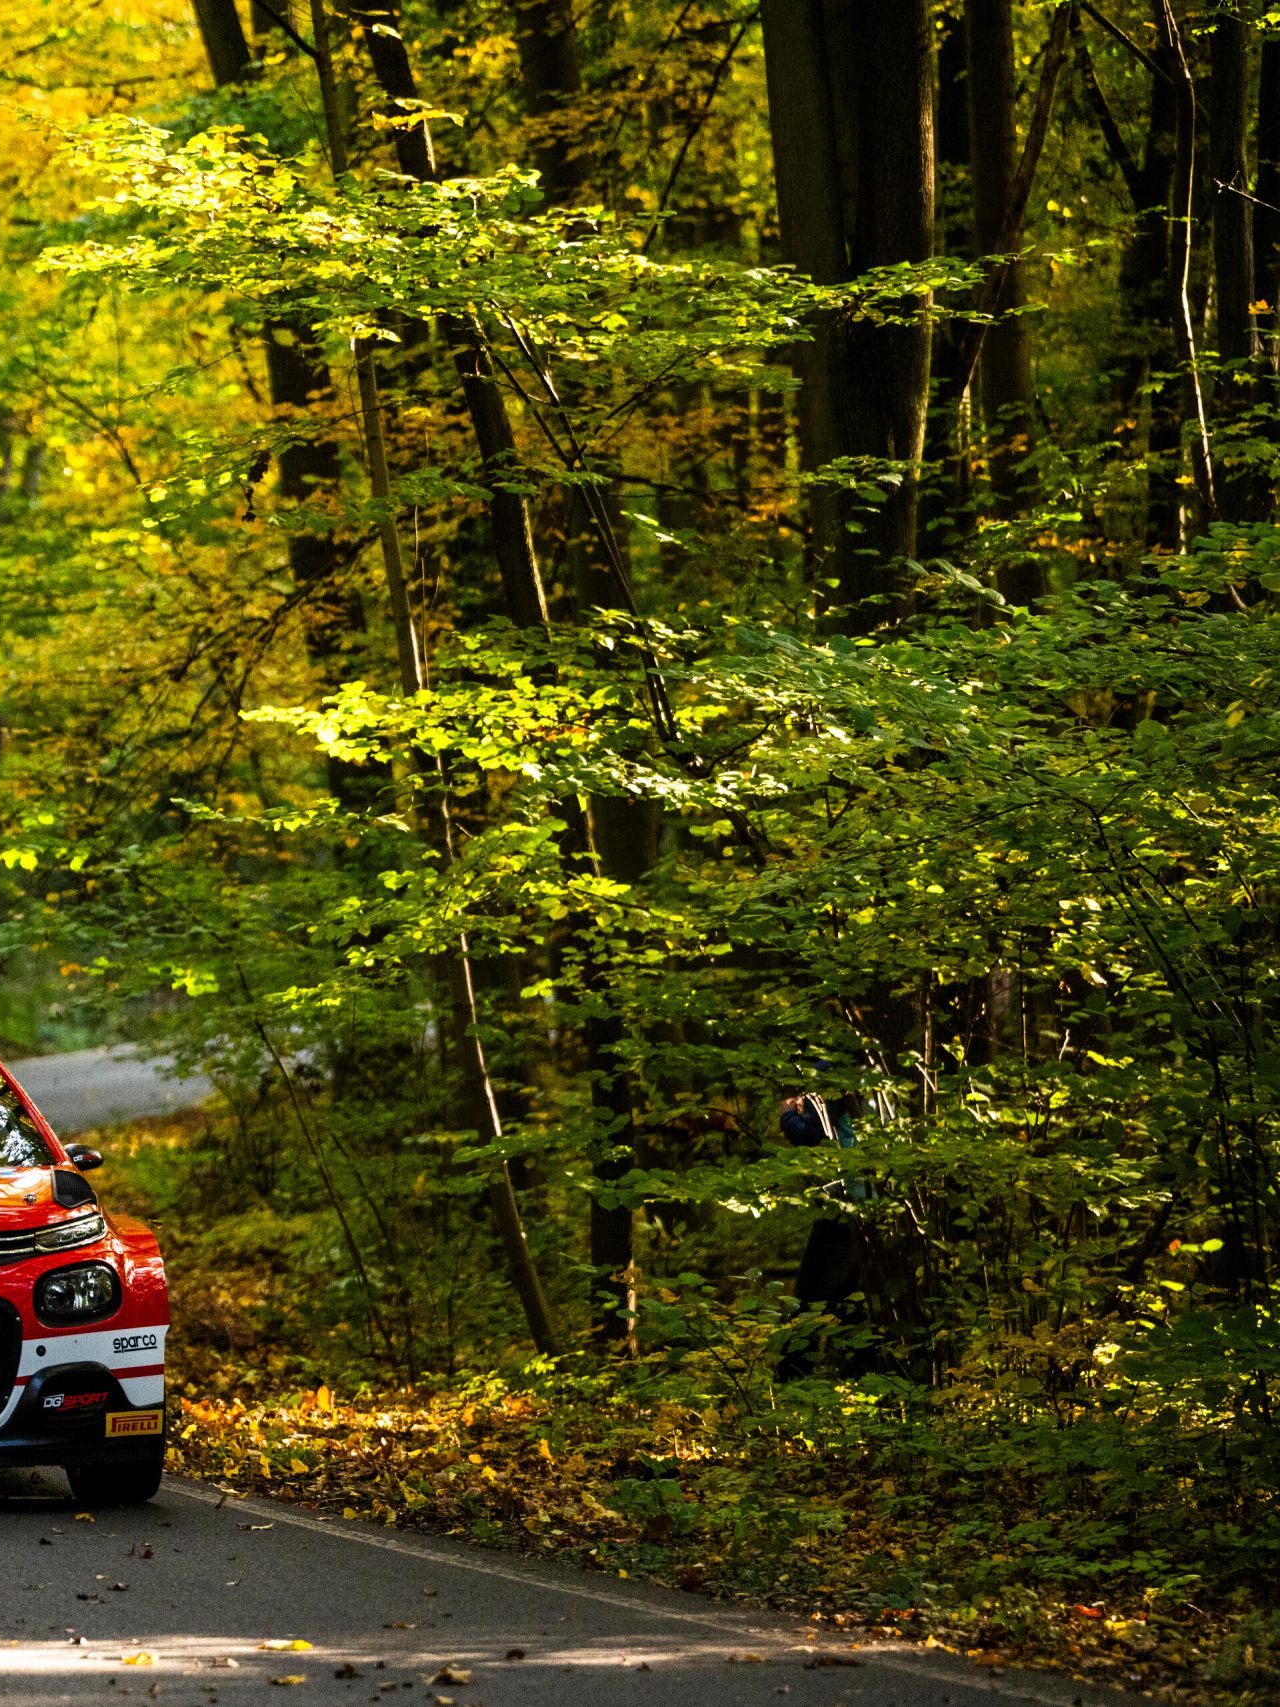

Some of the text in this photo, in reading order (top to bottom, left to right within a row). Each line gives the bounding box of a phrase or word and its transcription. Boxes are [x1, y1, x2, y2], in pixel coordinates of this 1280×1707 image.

[113, 1334, 158, 1354] sparco
[62, 1391, 109, 1407] SPORT
[111, 1414, 159, 1435] PIRELLI
